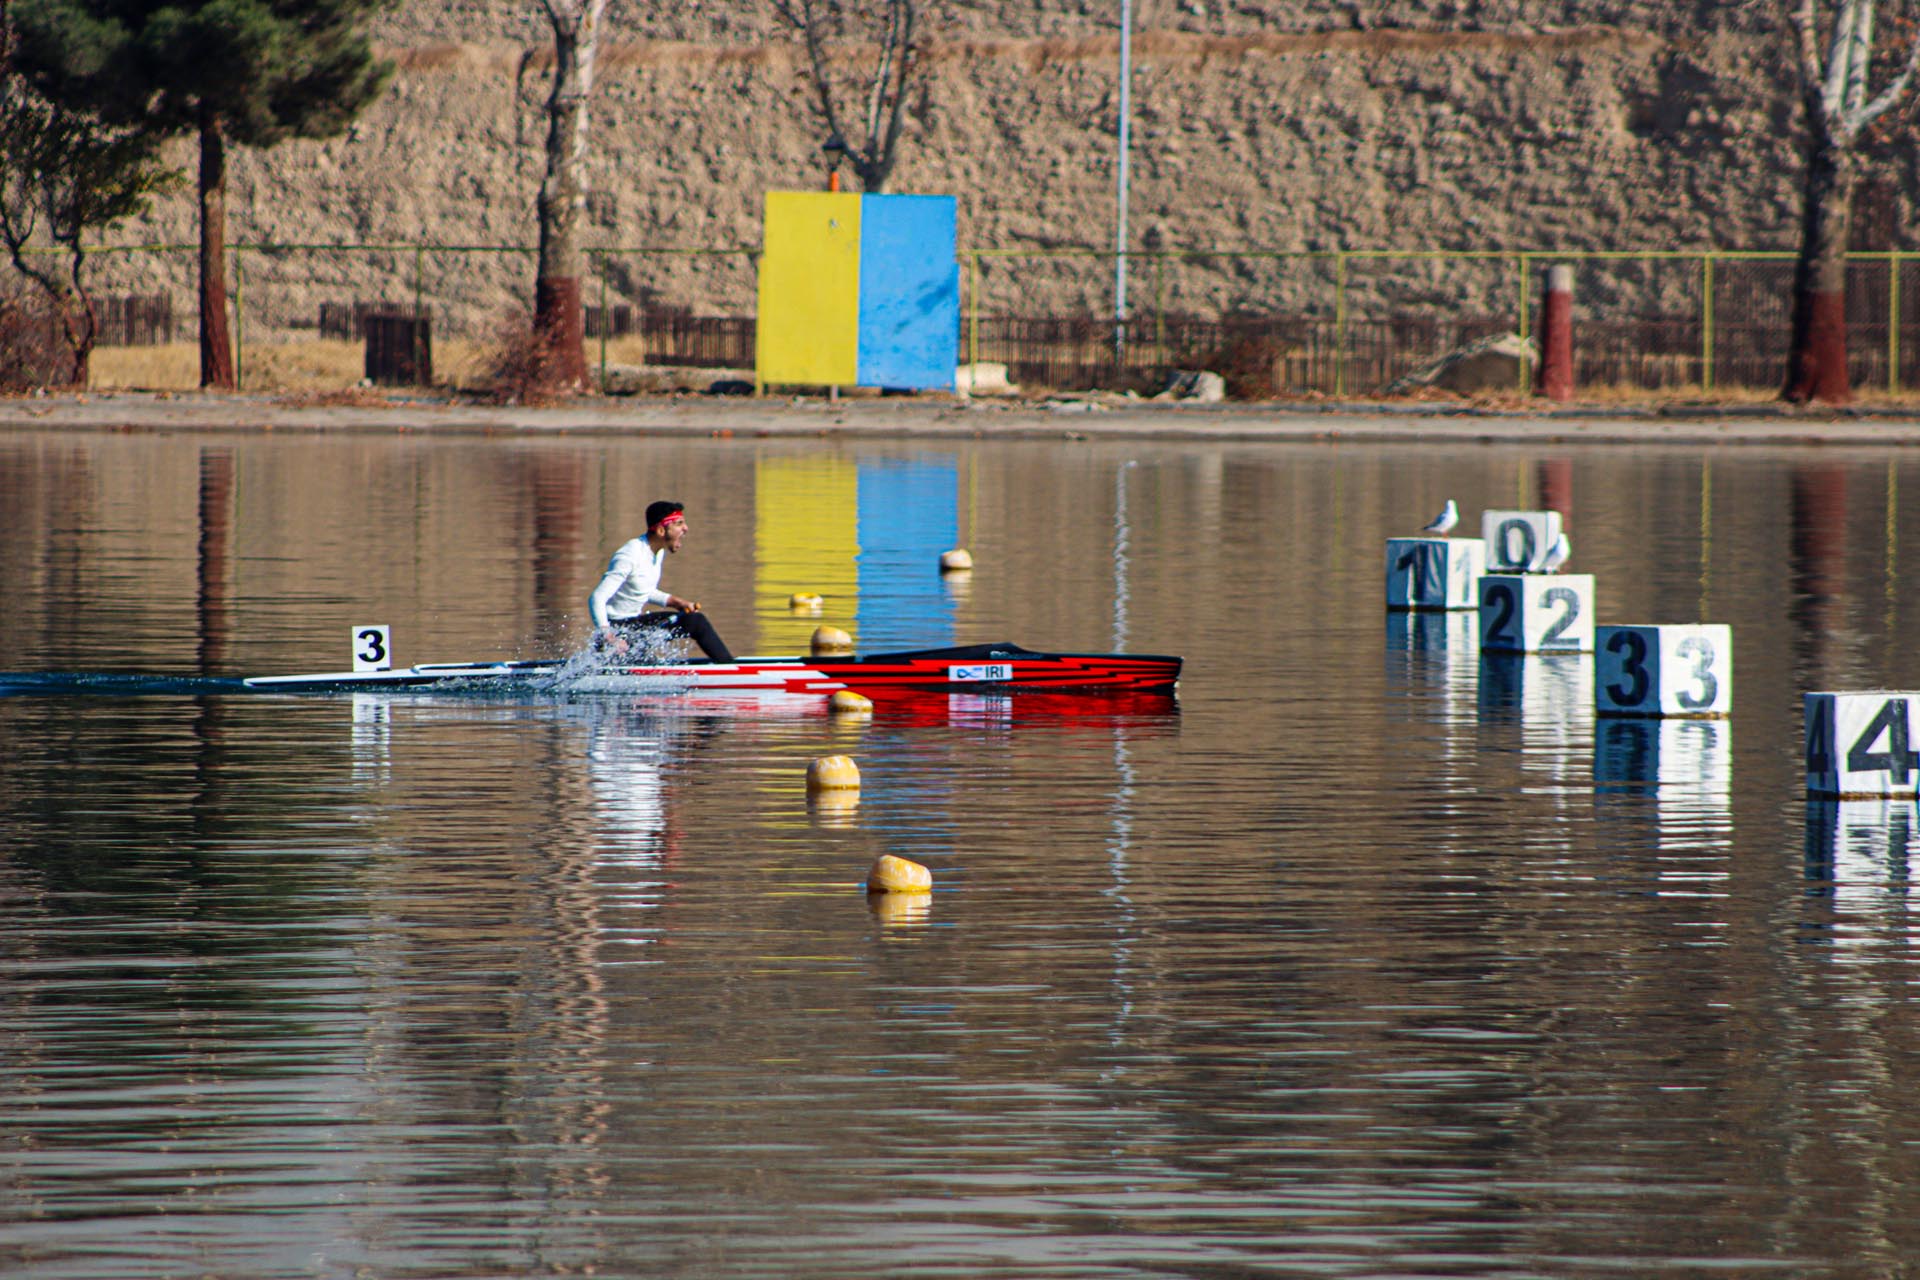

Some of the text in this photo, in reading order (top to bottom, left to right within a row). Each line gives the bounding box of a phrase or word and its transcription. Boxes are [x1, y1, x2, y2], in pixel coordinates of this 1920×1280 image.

[1495, 518, 1536, 566] 0
[1397, 543, 1427, 603] 1
[1456, 546, 1470, 603] 1
[1484, 584, 1515, 642] 2
[1538, 587, 1580, 650] 2
[358, 630, 386, 663] 3
[985, 665, 1004, 678] IRI
[1605, 630, 1649, 707] 3
[1675, 636, 1718, 711] 3
[1806, 699, 1828, 788] 4
[1847, 698, 1920, 785] 4
